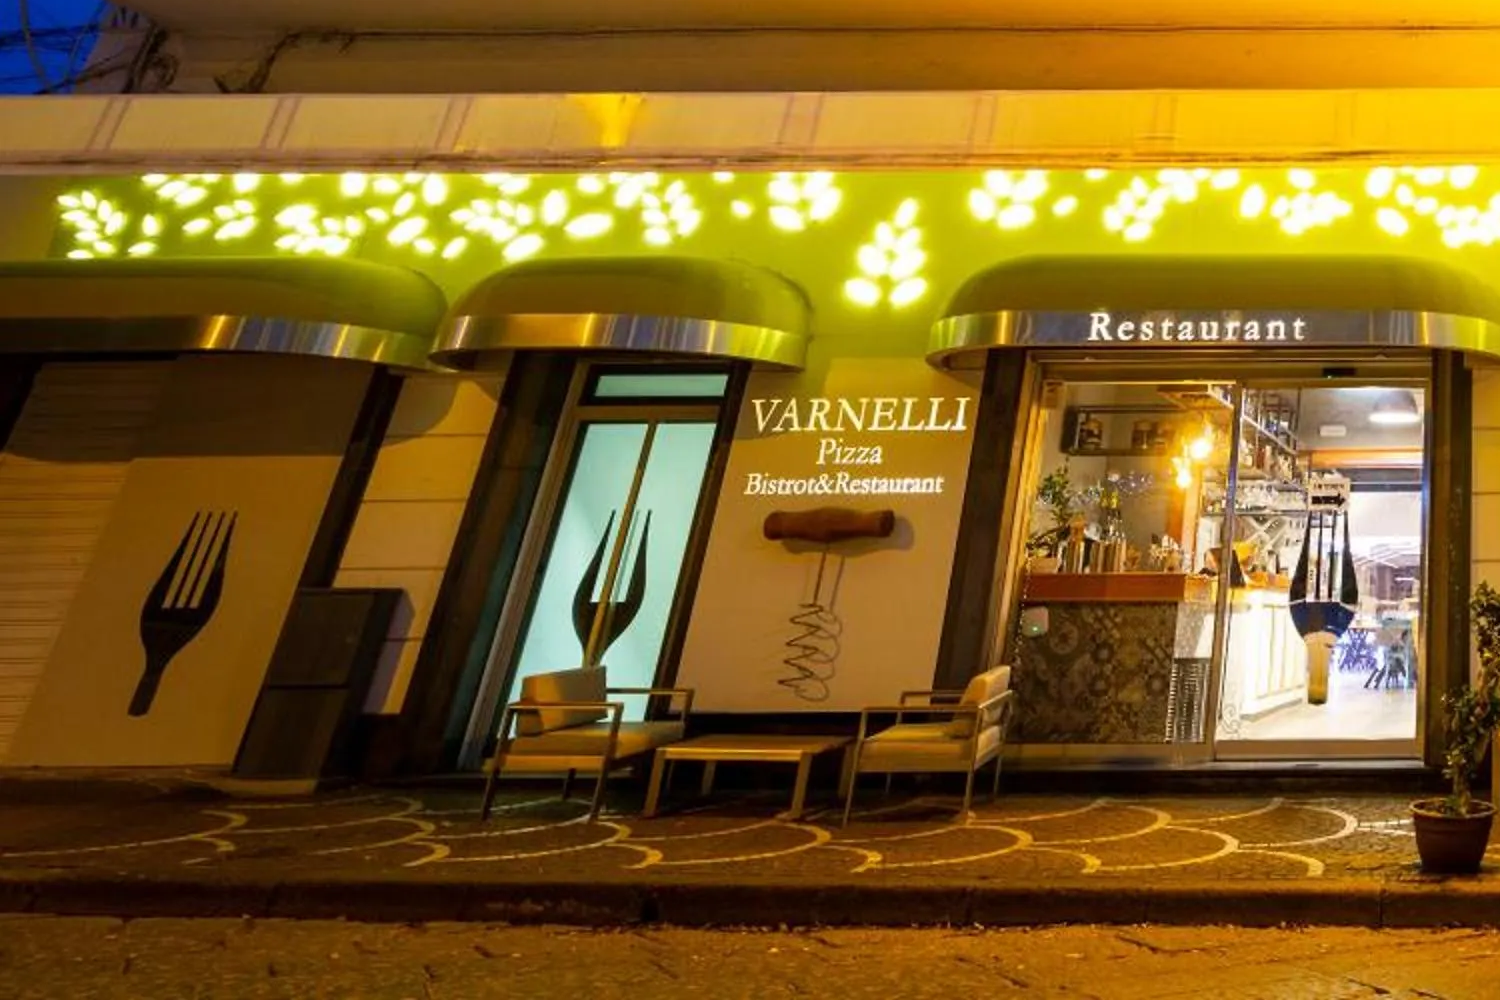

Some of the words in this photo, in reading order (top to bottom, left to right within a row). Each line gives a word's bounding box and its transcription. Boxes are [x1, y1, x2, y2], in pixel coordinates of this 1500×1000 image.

[1088, 312, 1305, 341] Restaurant
[752, 398, 970, 432] VARNELLI
[816, 438, 882, 465] Pizza
[744, 471, 944, 495] Bistrot&Restaurant
